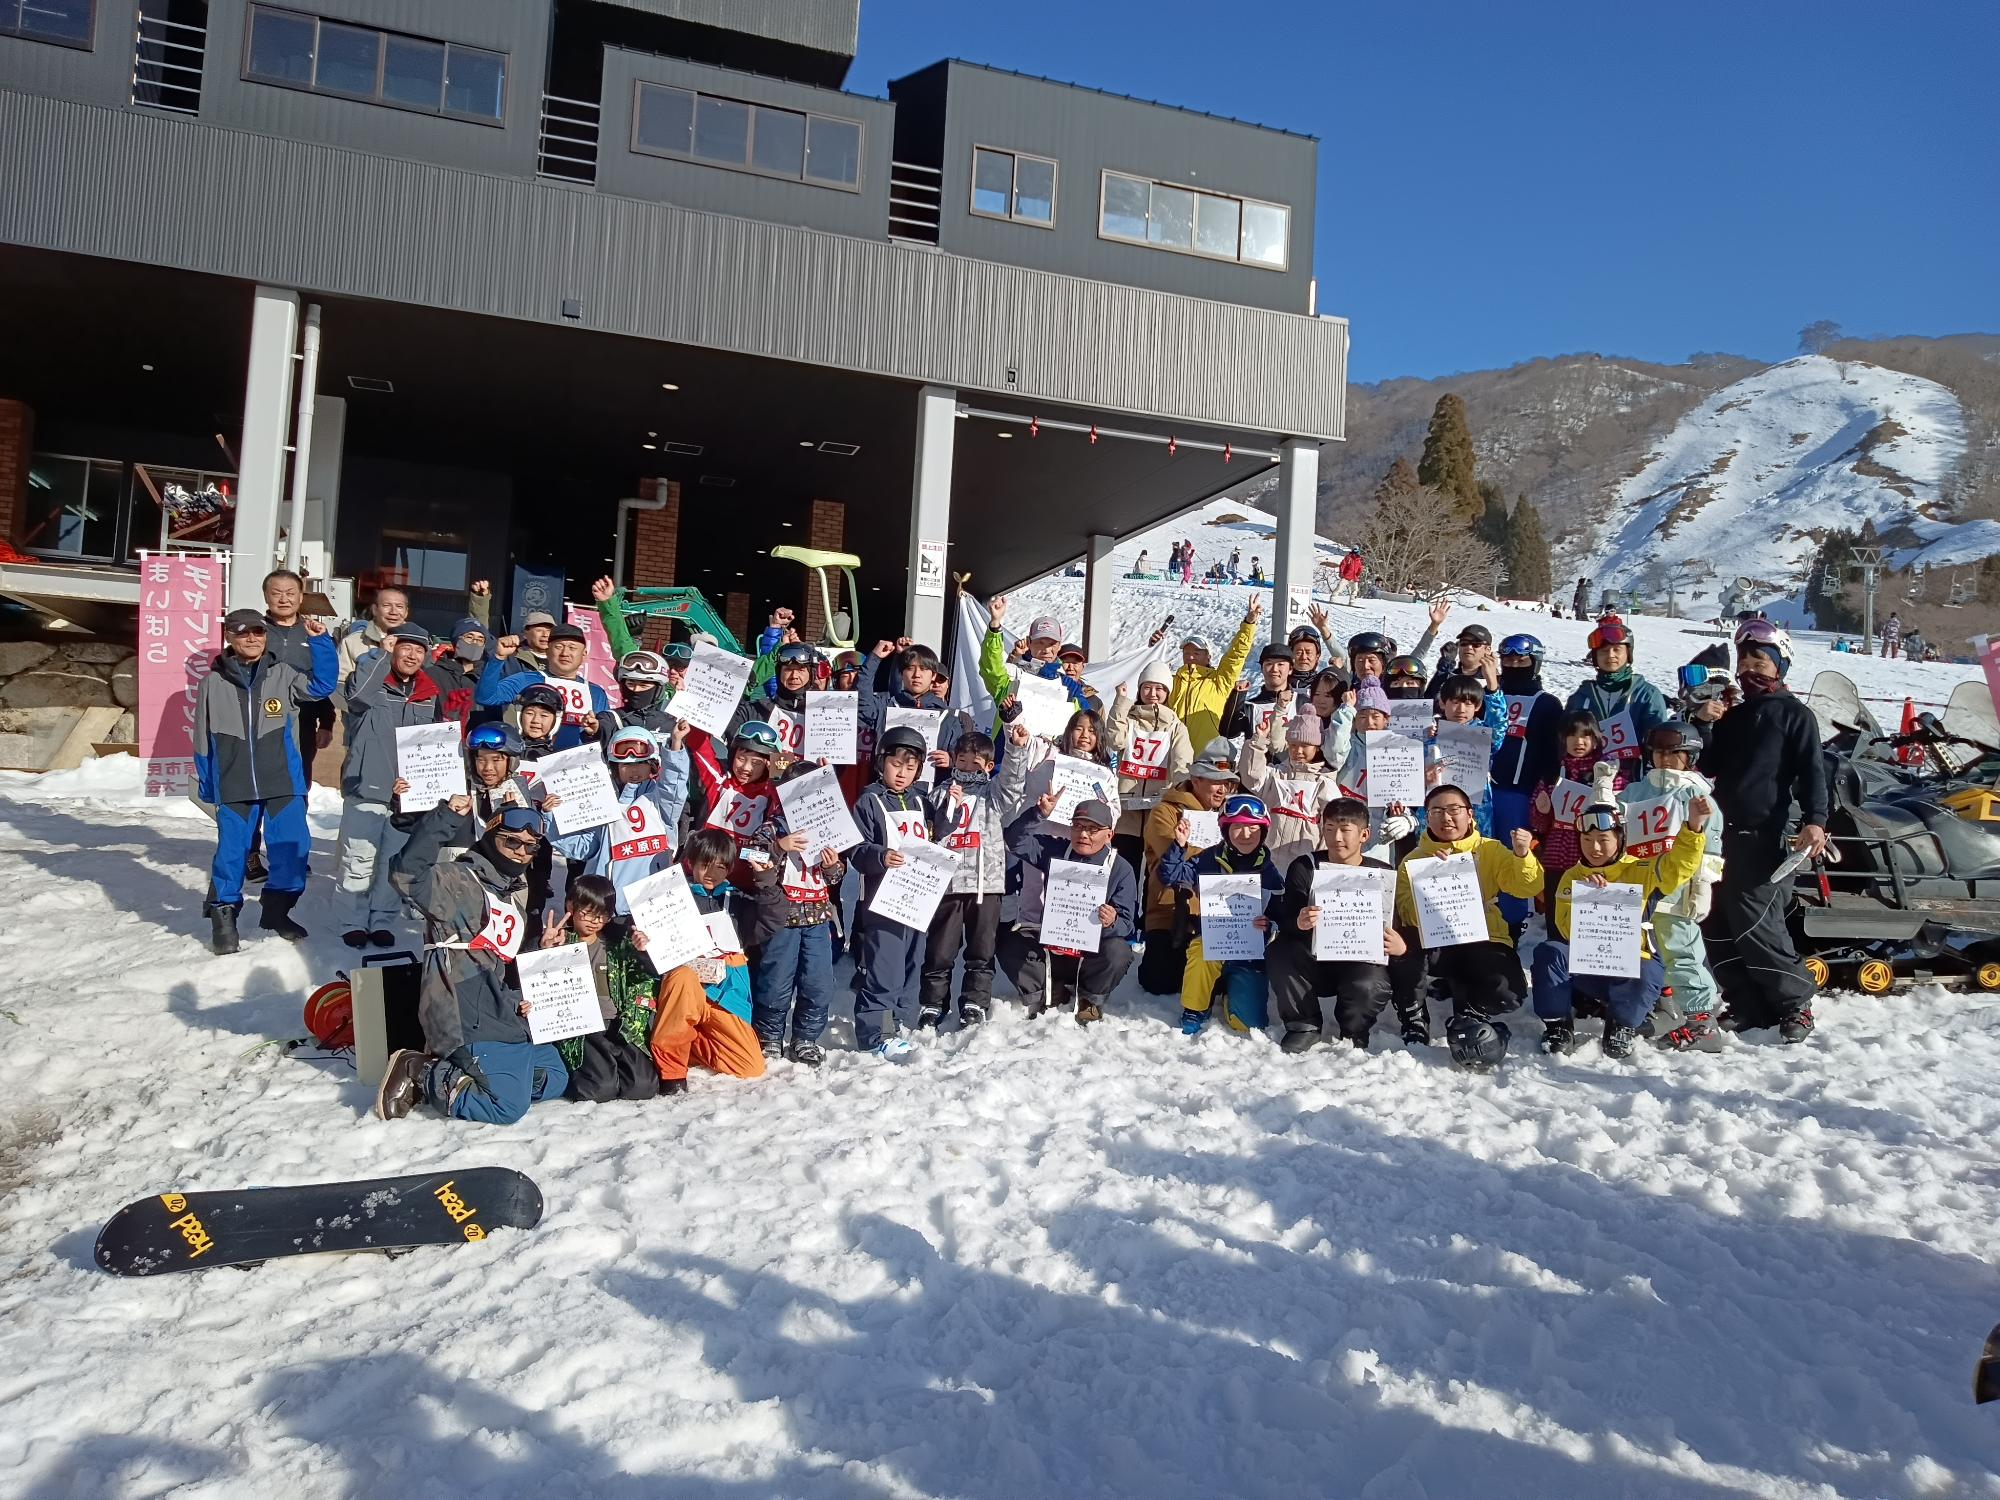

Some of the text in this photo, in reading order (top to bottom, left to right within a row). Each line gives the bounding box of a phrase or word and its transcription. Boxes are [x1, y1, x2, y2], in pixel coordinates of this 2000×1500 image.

[778, 719, 803, 748] 30
[1132, 737, 1161, 761] 57
[1126, 764, 1159, 778] 米原市
[627, 806, 645, 832] 9
[1638, 806, 1669, 835] 12
[621, 838, 661, 856] 米原市
[1637, 838, 1675, 857] 米原市
[170, 1199, 184, 1210] 20
[433, 1180, 476, 1223] head
[169, 1211, 214, 1258] head
[467, 1226, 479, 1237] 20
